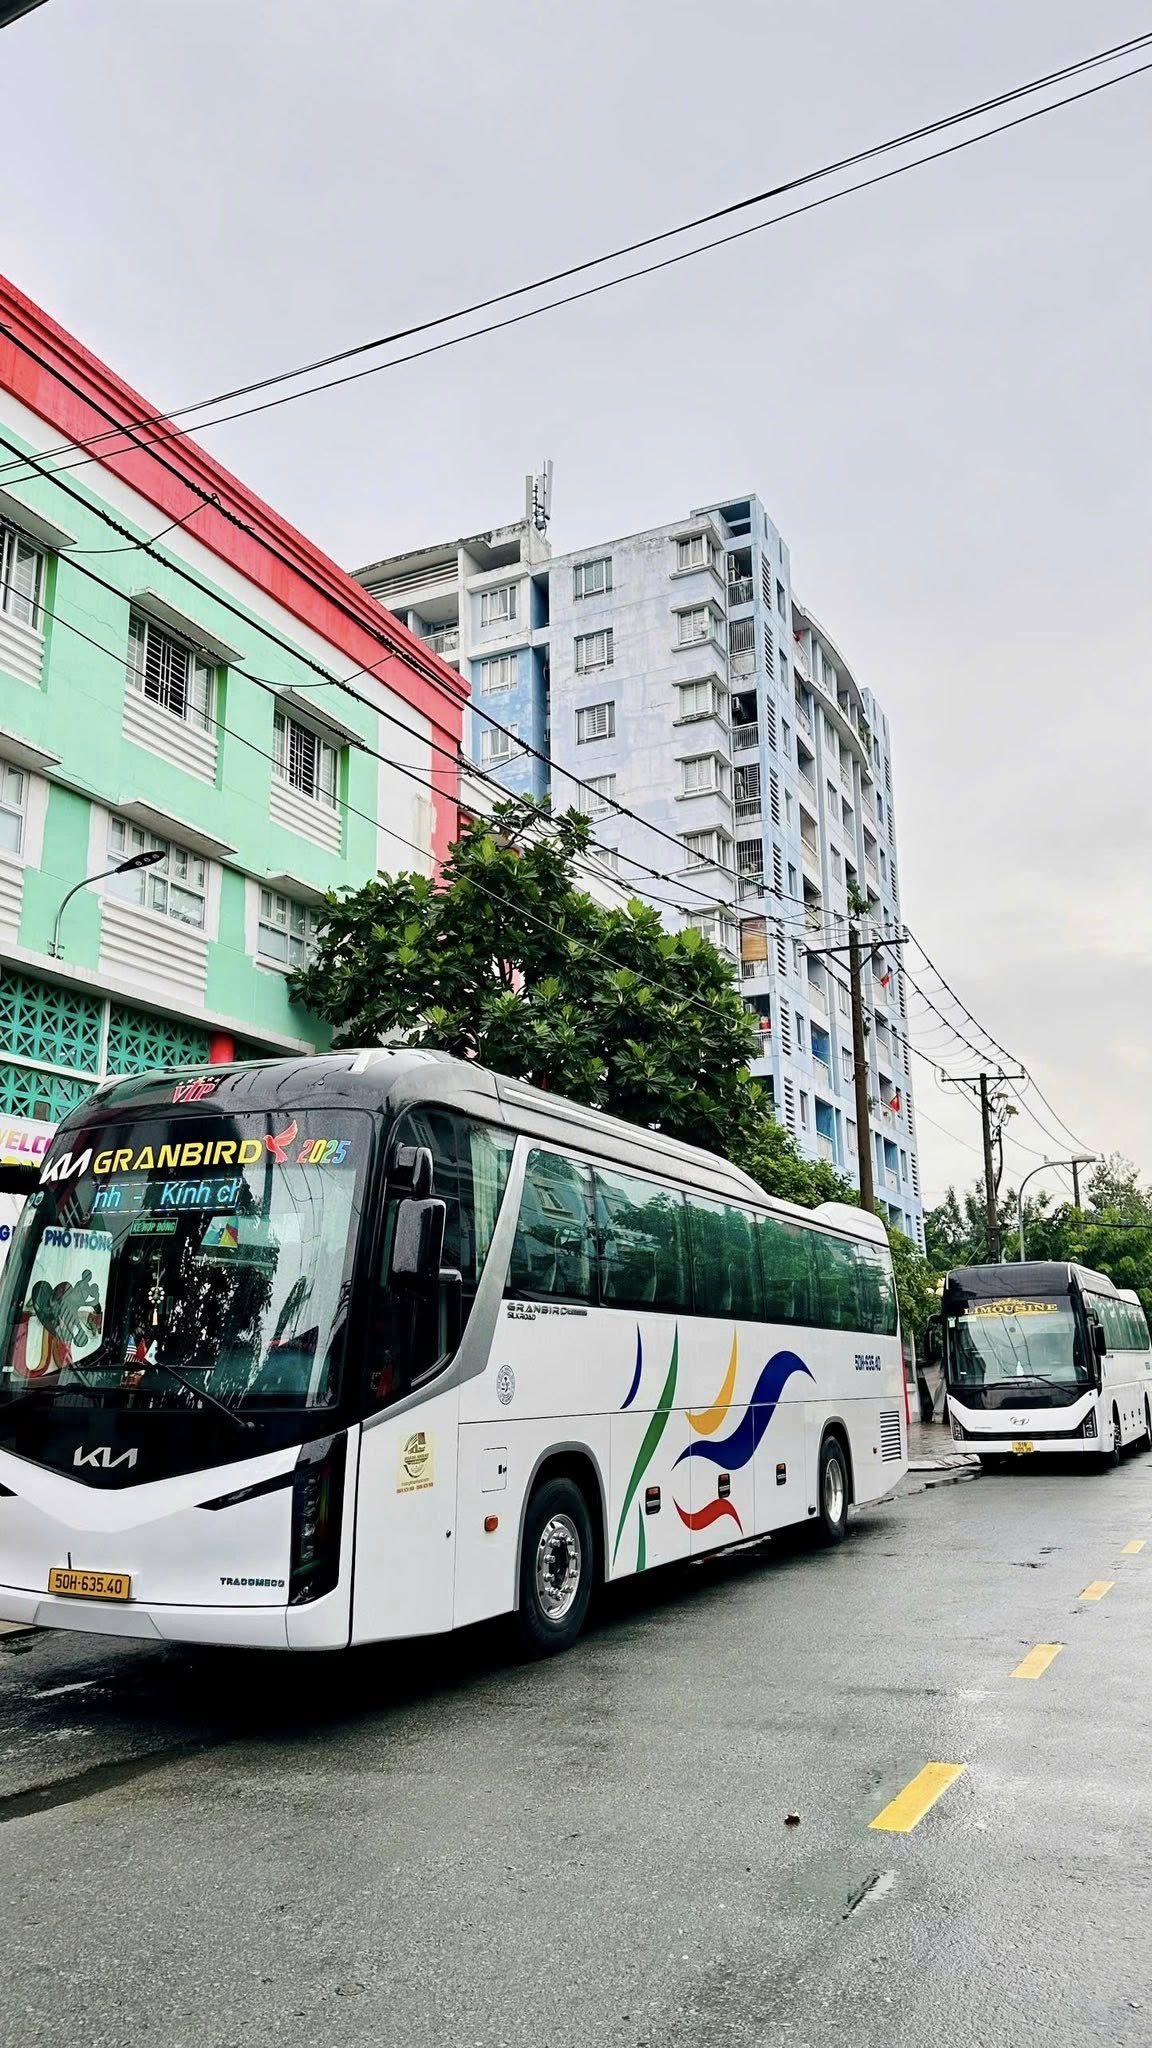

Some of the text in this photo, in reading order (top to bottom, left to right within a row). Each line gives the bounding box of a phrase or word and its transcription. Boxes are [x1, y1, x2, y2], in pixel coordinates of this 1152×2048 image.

[172, 1081, 216, 1104] VIP
[94, 1140, 262, 1174] GRANBIRD
[296, 1140, 350, 1164] 2025
[160, 1182, 210, 1205] Kính
[507, 1302, 568, 1316] GRANBIRD
[964, 1304, 1058, 1315] LIMOUSINE
[73, 1446, 138, 1468] KIA
[55, 1573, 122, 1595] 50H-635.40
[220, 1577, 285, 1588] TRACOMECO
